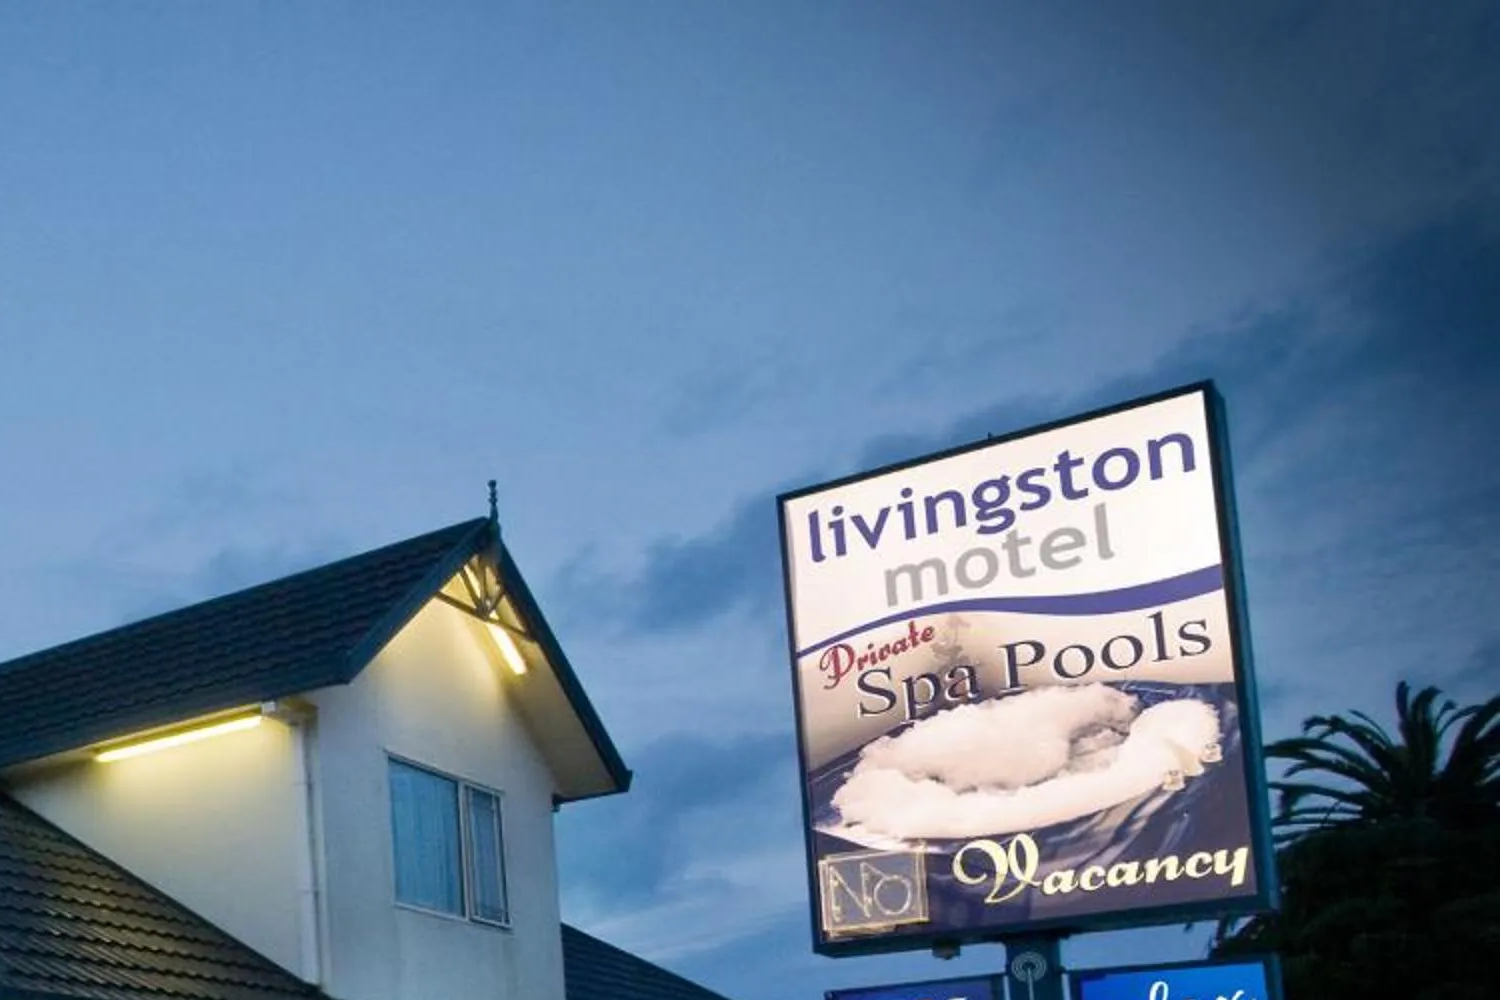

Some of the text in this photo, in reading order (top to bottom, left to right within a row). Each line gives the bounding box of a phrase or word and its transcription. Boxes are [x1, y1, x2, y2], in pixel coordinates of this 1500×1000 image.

[808, 433, 1196, 563] livingston
[884, 502, 1115, 608] motel
[819, 620, 936, 690] Private
[856, 611, 1212, 726] Spa Pools
[952, 833, 1249, 903] Vacancy
